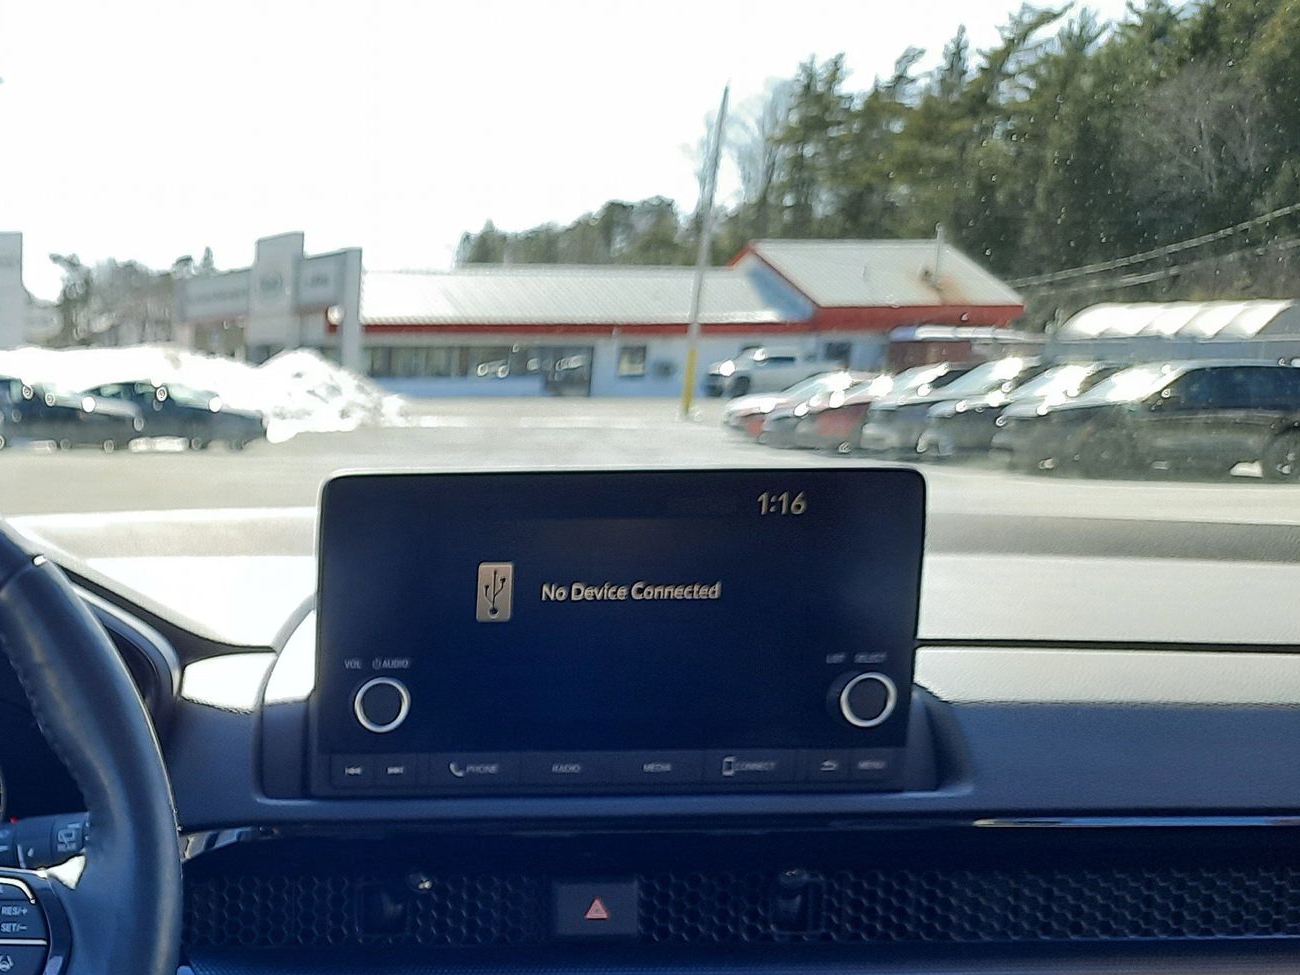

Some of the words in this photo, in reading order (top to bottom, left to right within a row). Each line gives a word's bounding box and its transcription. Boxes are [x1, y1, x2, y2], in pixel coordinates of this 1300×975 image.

[757, 491, 807, 515] 1:16
[541, 583, 567, 601] No
[571, 582, 628, 601] Device
[631, 581, 721, 600] Connected
[344, 659, 361, 669] VOL
[382, 659, 409, 669] AUDIO
[552, 764, 581, 773] RADIO
[643, 763, 672, 773] MEDIA
